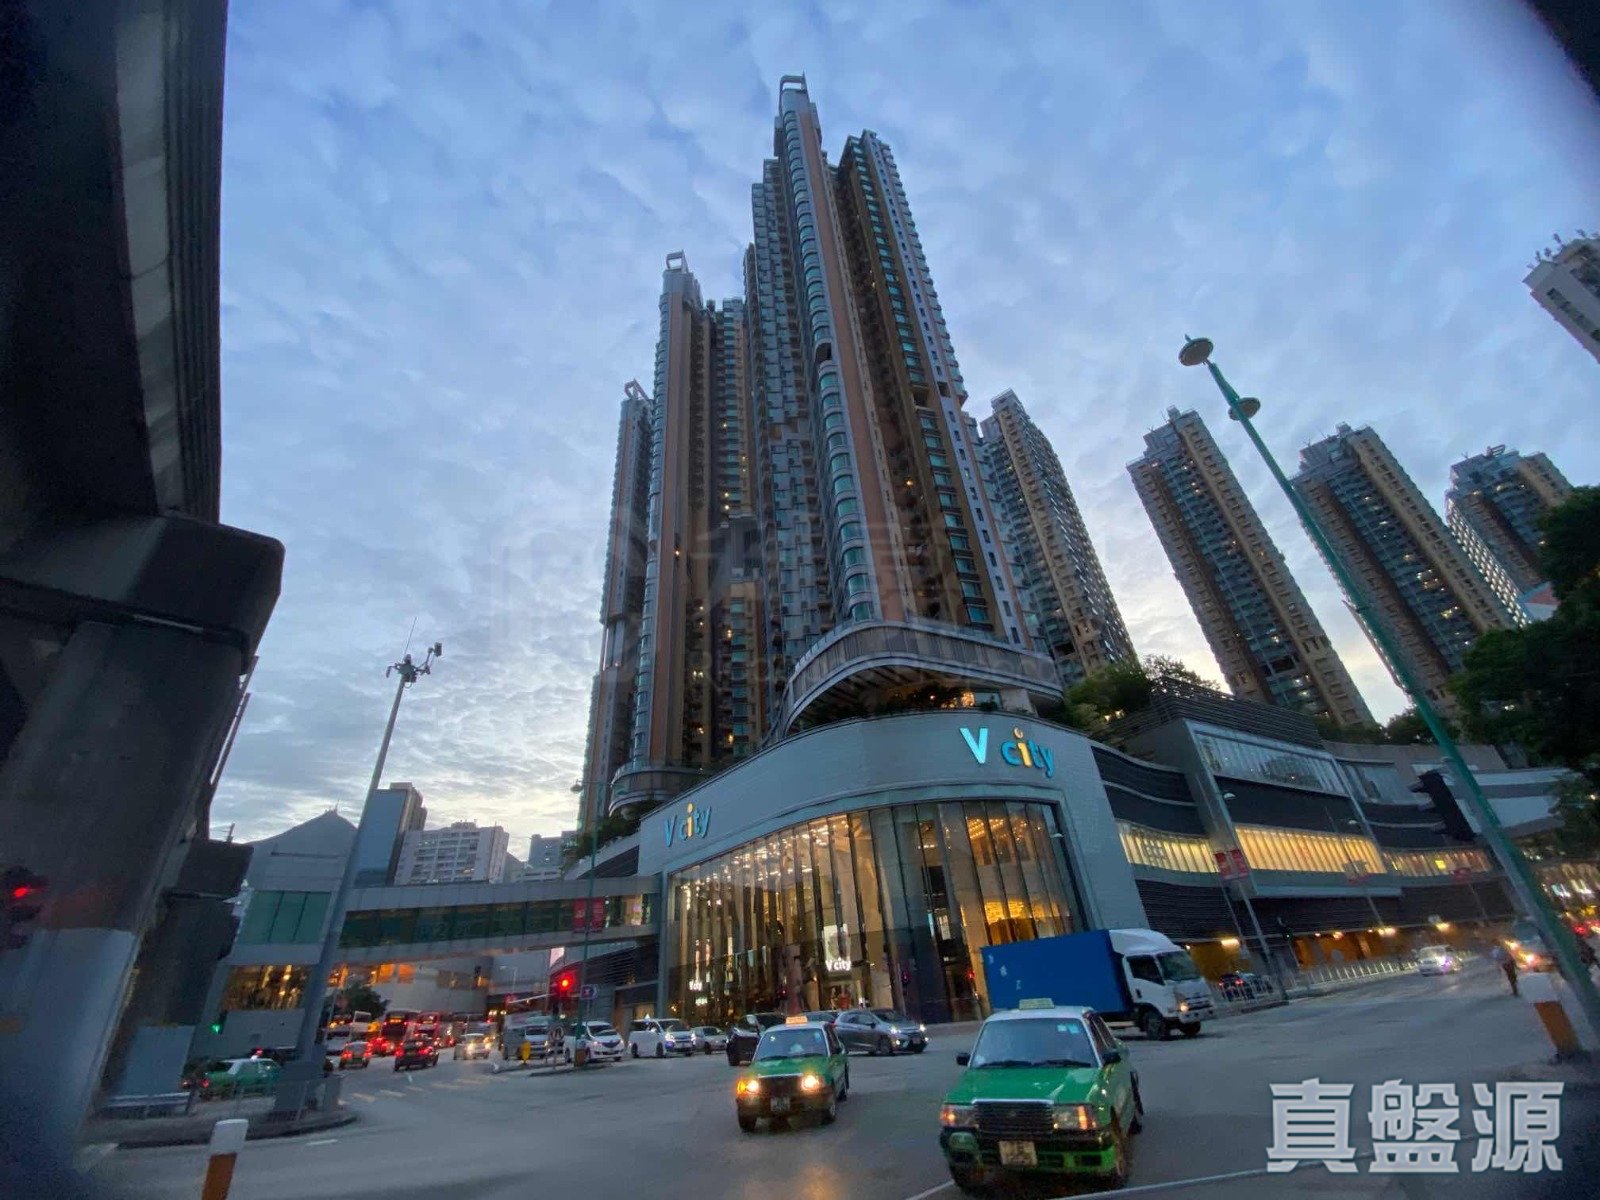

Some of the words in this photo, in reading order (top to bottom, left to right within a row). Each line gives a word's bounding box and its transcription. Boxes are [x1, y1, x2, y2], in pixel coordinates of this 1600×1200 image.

[960, 727, 988, 764] V
[1001, 726, 1055, 778] city
[664, 815, 677, 847] V
[679, 802, 711, 840] city
